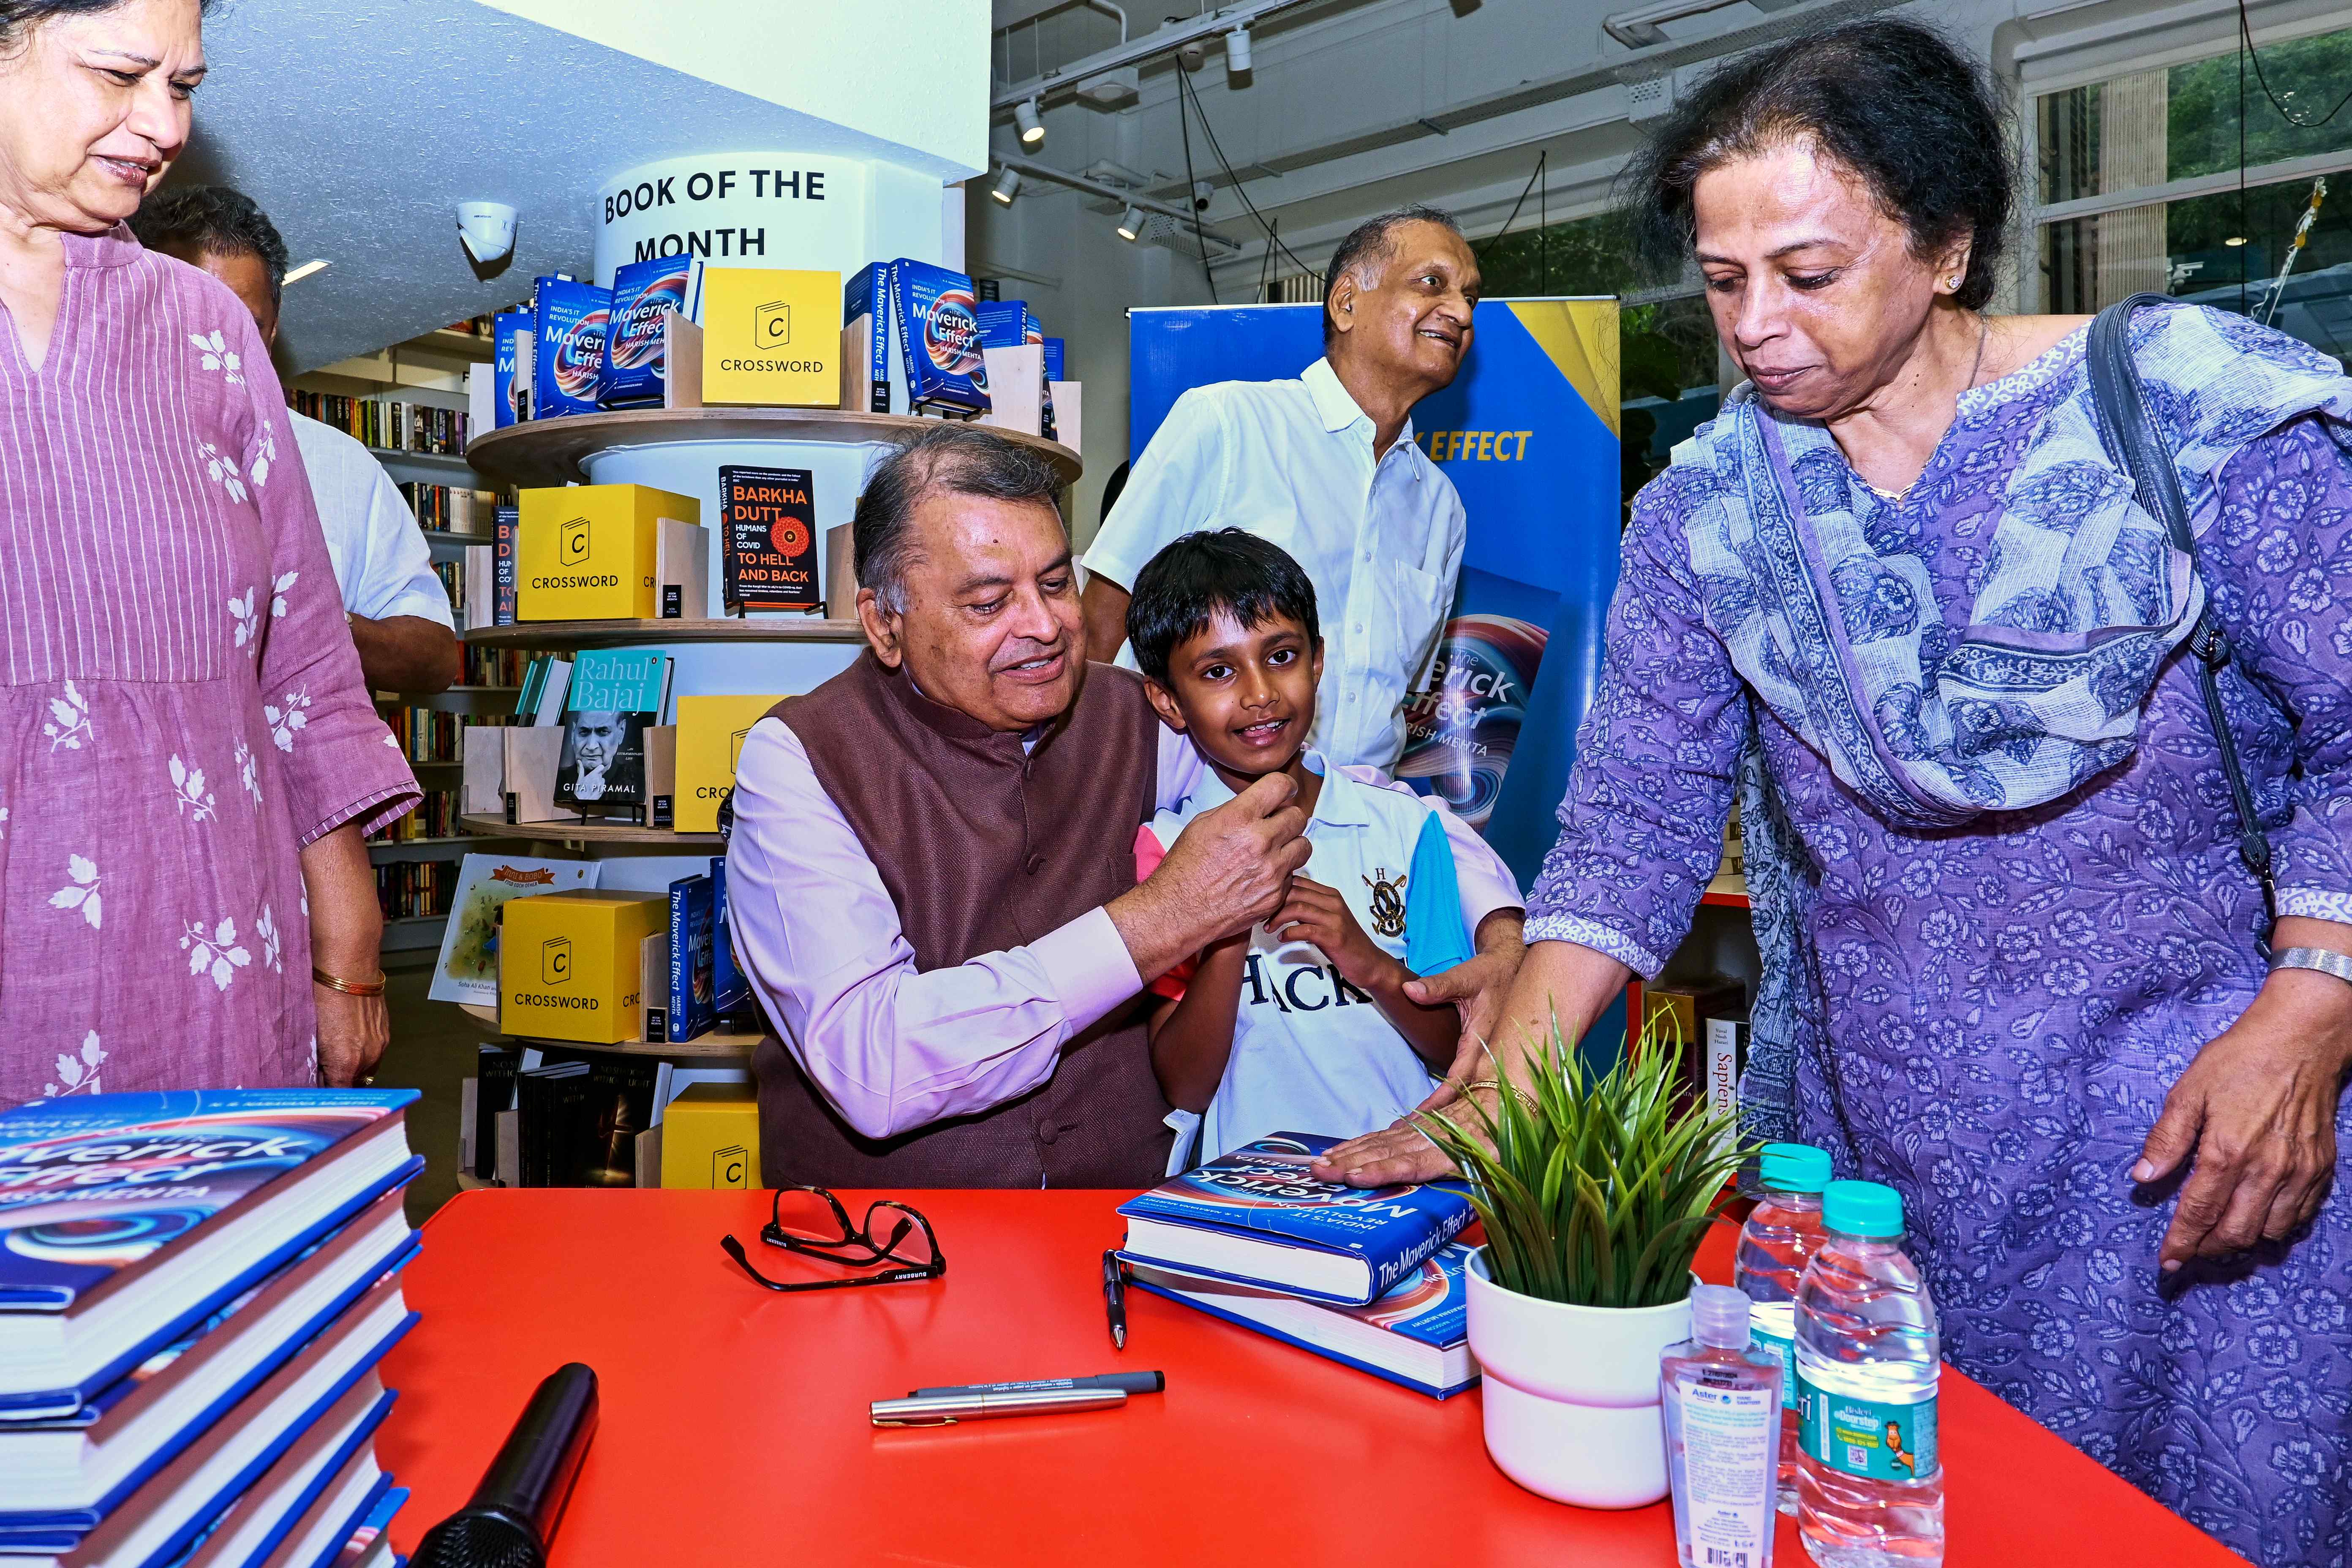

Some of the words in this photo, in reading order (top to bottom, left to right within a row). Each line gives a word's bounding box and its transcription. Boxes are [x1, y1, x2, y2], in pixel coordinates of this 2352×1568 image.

[605, 176, 676, 225] BOOK
[687, 170, 736, 201] OF
[749, 169, 825, 200] THE
[635, 228, 765, 263] MONTH
[877, 268, 886, 286] The
[617, 287, 634, 296] INDIA'S
[912, 284, 931, 294] INDIA'S
[615, 292, 649, 304] REVOLUTION
[912, 292, 945, 305] REVOLUTION
[550, 305, 573, 315] INDIA'S
[609, 298, 680, 325] Maverick
[875, 287, 886, 334] Maverick
[893, 283, 905, 325] Maverick
[900, 326, 910, 352] Effect
[912, 302, 978, 333] Maverick
[549, 314, 590, 326] REVOLUTION
[769, 318, 784, 337] C
[545, 325, 605, 351] Maveri
[629, 321, 664, 338] Effec
[939, 327, 973, 348] Effect
[626, 340, 649, 349] HARISH
[650, 338, 664, 346] MEH
[875, 335, 885, 365] Effect
[574, 351, 602, 368] Effe
[940, 345, 961, 355] HARISH
[962, 351, 981, 360] MEHTA
[721, 359, 823, 373] CROSSWORD
[572, 370, 599, 380] HARISH
[1429, 431, 1533, 461] EFFECT
[733, 486, 808, 505] BARKHA
[735, 505, 782, 521] DUTT
[723, 525, 729, 537] TO
[735, 524, 767, 532] HUMANS
[572, 534, 585, 553] C
[737, 552, 757, 564] TO
[760, 553, 794, 566] HELL
[532, 575, 618, 589] CROSSWORD
[738, 569, 768, 581] AND
[771, 570, 809, 583] BACK
[1456, 649, 1478, 666] The
[580, 657, 648, 681] Rahul
[1432, 660, 1515, 702] erick
[575, 681, 644, 716] Bajaj
[1406, 722, 1437, 740] RISH
[1438, 735, 1488, 757] MEHTA
[563, 783, 586, 792] GITA
[591, 784, 636, 793] PIRAMAL
[525, 871, 542, 880] BOBO
[1375, 868, 1386, 880] H
[672, 890, 681, 909] The
[672, 911, 681, 959] Maverick
[689, 933, 713, 953] Maver
[553, 953, 566, 973] C
[671, 961, 681, 991] Effect
[514, 993, 599, 1010] CROSSWORD
[1712, 1052, 1733, 1116] Sapiens
[1235, 1155, 1293, 1169] MEHTA
[726, 1162, 742, 1183] C
[1230, 1164, 1348, 1192] Effect
[1186, 1171, 1418, 1219] Maverick
[1231, 1187, 1265, 1197] The
[1142, 1198, 1179, 1207] MURTHY
[1179, 1204, 1222, 1214] NARAYANA
[1272, 1202, 1389, 1225] REVOLUTION
[1310, 1214, 1377, 1230] INDIA'S
[766, 1237, 787, 1247] BURBERRY
[1379, 1260, 1398, 1288] The
[1399, 1226, 1441, 1274] Maverick
[1442, 1208, 1467, 1242] Effect
[894, 1271, 927, 1280] BURBERRY
[1411, 1316, 1436, 1328] MURTHY
[1692, 1388, 1718, 1400] Aster
